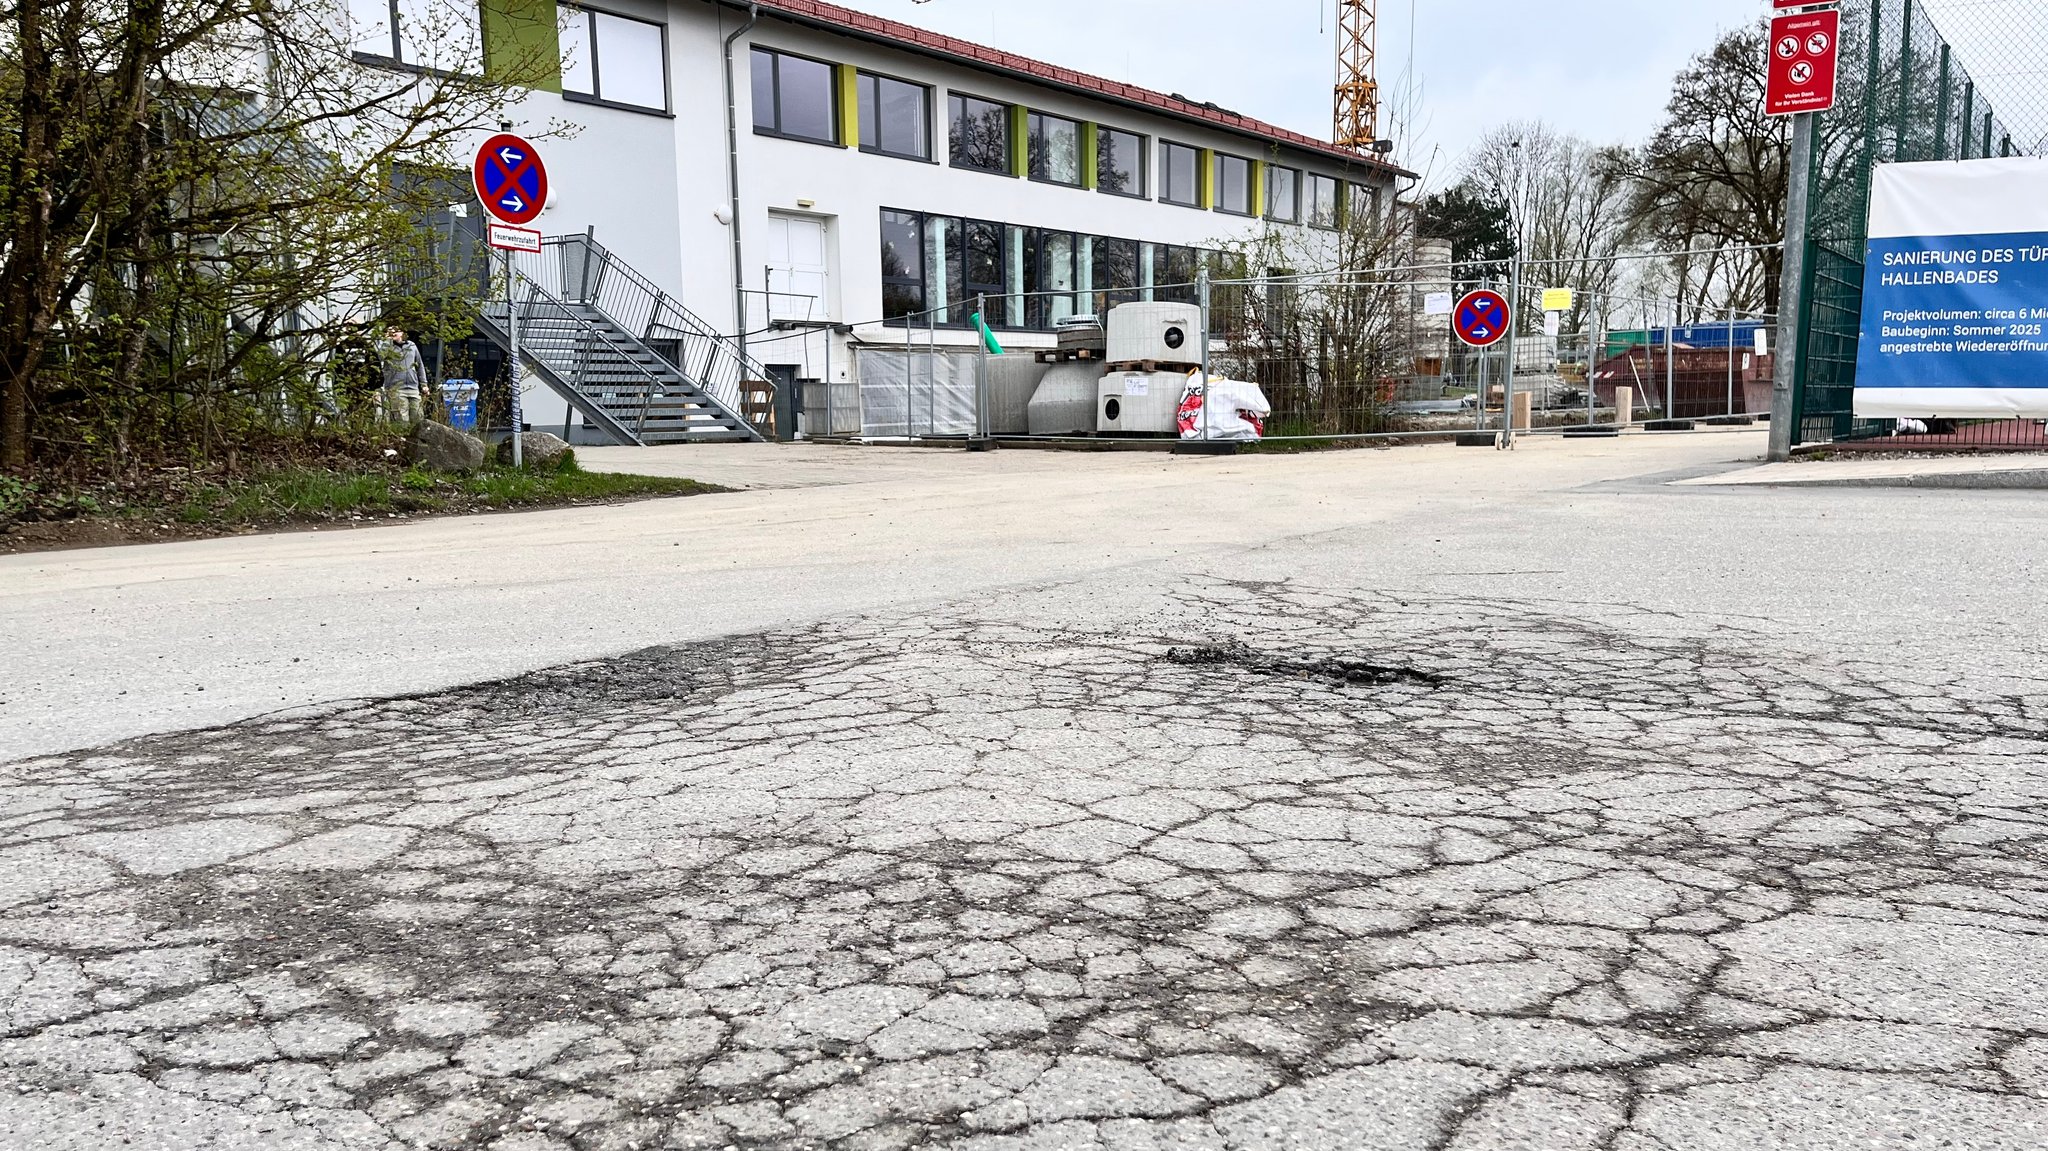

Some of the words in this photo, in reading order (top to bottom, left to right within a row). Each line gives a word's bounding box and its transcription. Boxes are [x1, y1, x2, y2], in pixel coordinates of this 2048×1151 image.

[494, 231, 536, 245] Feuerwehrzufahrt
[1883, 250, 1977, 266] SANIERUNG
[1981, 248, 2014, 263] DES
[1881, 269, 1999, 286] HALLENBADES
[1883, 309, 1981, 323] Projektvolumen:
[1984, 307, 2015, 319] circa
[2019, 308, 2027, 319] 6
[2030, 307, 2048, 319] Mi
[1881, 325, 1950, 338] Baubeginn:
[1953, 325, 2006, 336] Sommer
[2009, 324, 2041, 335] 2025
[1880, 341, 1953, 355] angestrebte
